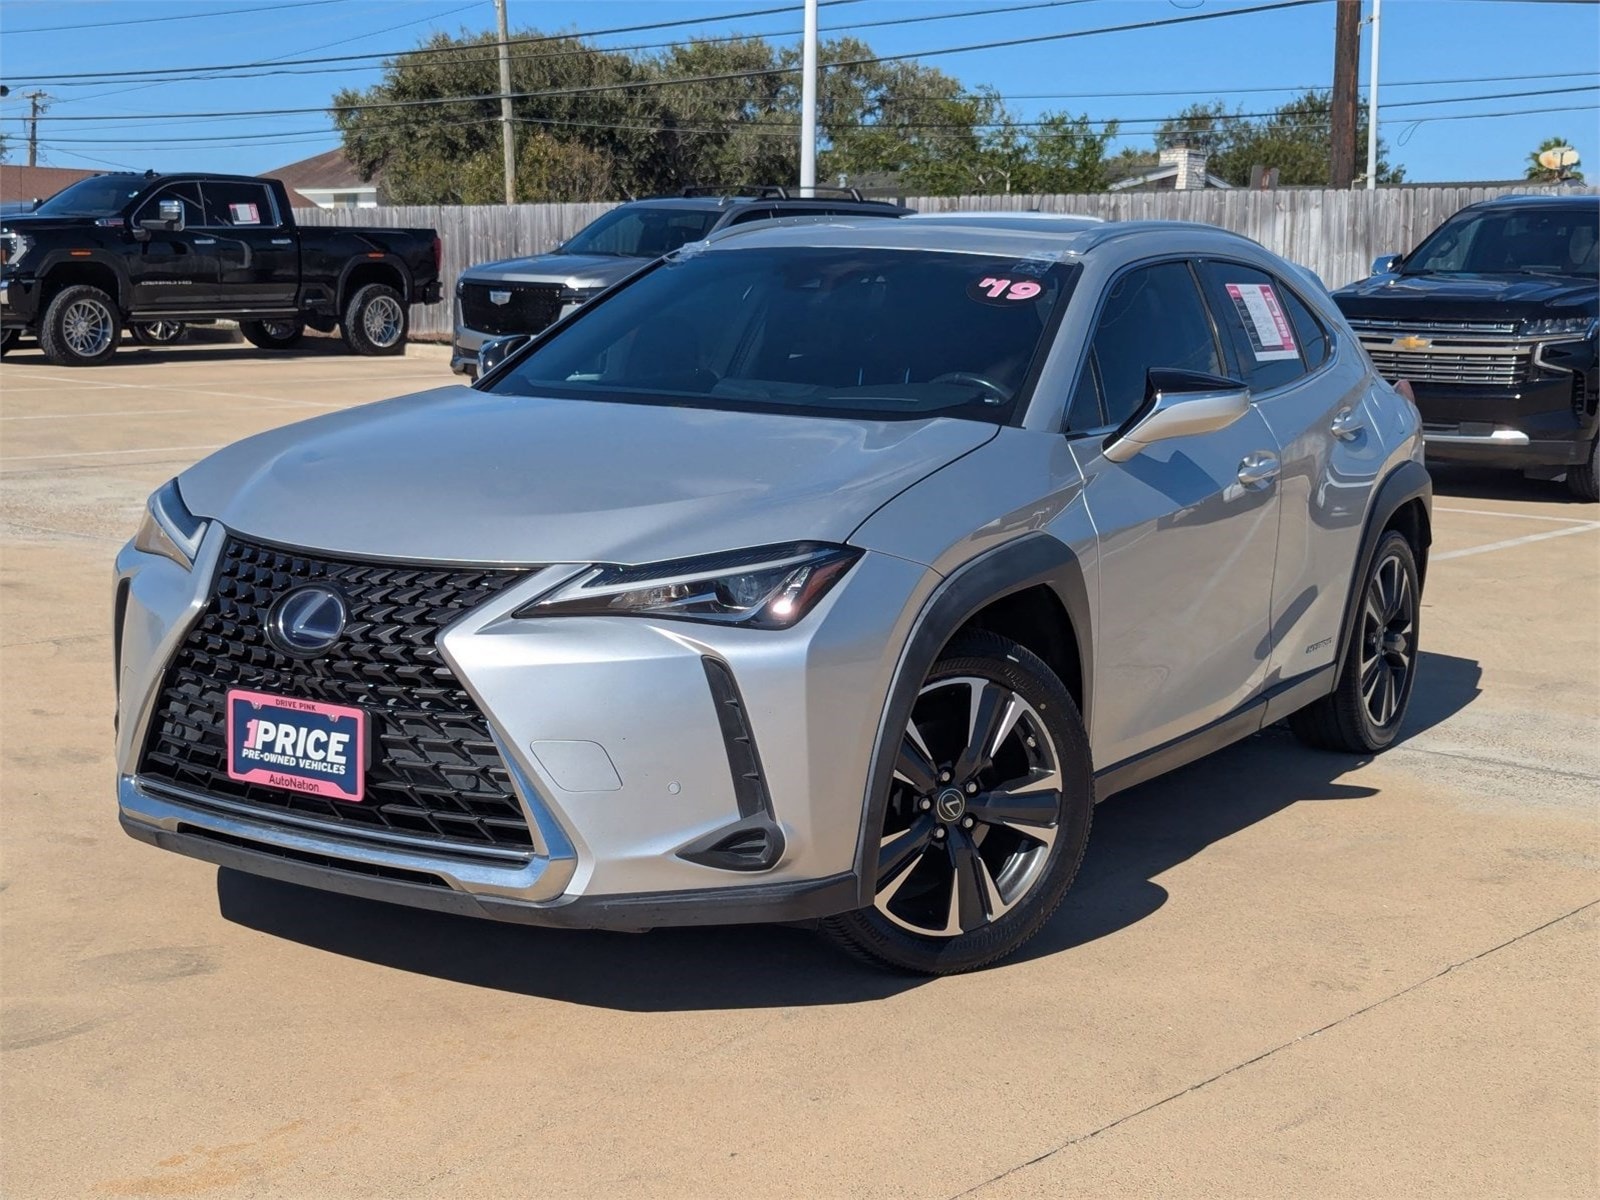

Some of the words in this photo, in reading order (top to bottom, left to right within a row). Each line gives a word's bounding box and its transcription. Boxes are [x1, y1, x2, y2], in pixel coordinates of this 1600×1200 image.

[979, 278, 1041, 300] '19
[275, 699, 297, 709] DRIVE
[299, 703, 316, 711] PINK
[242, 749, 296, 766] PRE-OWNED
[298, 759, 346, 775] VEHICLES
[268, 774, 320, 792] AutoNation
